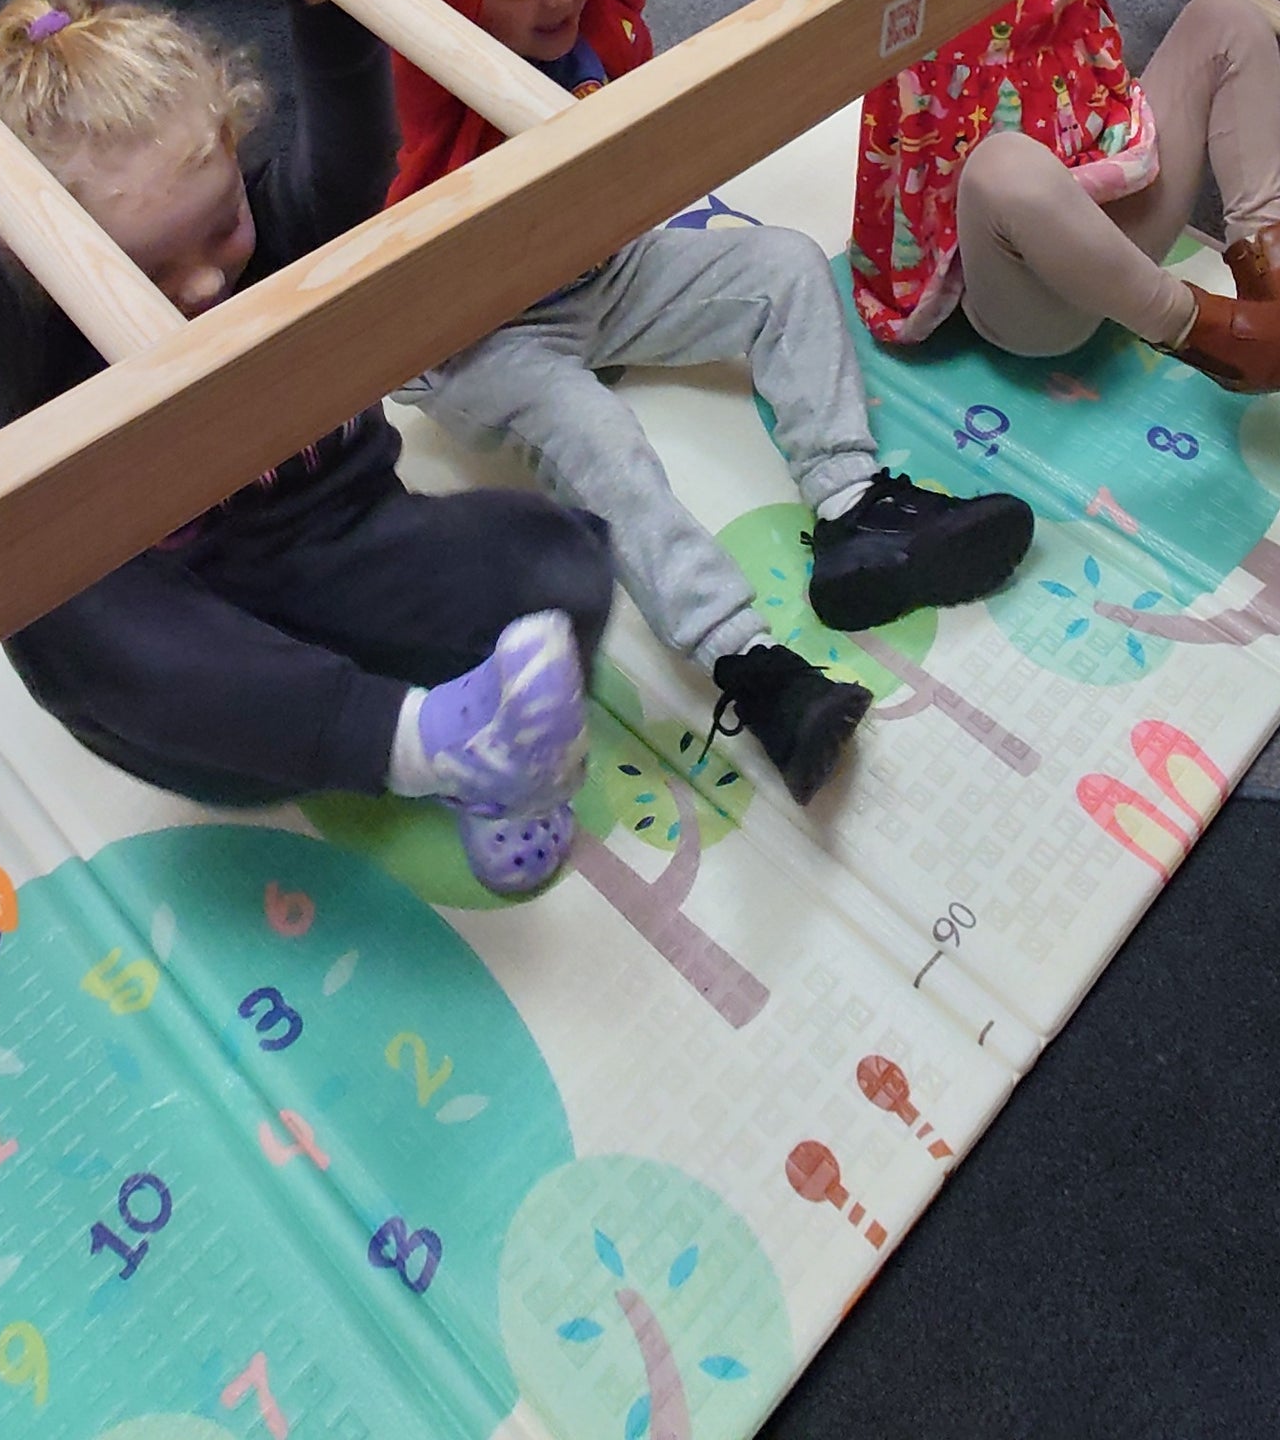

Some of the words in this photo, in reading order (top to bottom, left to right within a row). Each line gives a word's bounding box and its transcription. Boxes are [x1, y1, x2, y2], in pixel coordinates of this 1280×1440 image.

[954, 404, 1010, 457] 10
[1146, 426, 1200, 460] 8
[264, 881, 314, 937] 6
[932, 901, 977, 948] 90
[82, 947, 159, 1015] 5
[238, 986, 304, 1051] 3
[386, 1032, 453, 1106] 2
[258, 1110, 331, 1171] 4
[89, 1172, 172, 1280] 10
[368, 1217, 443, 1294] 8
[221, 1352, 288, 1440] 7
